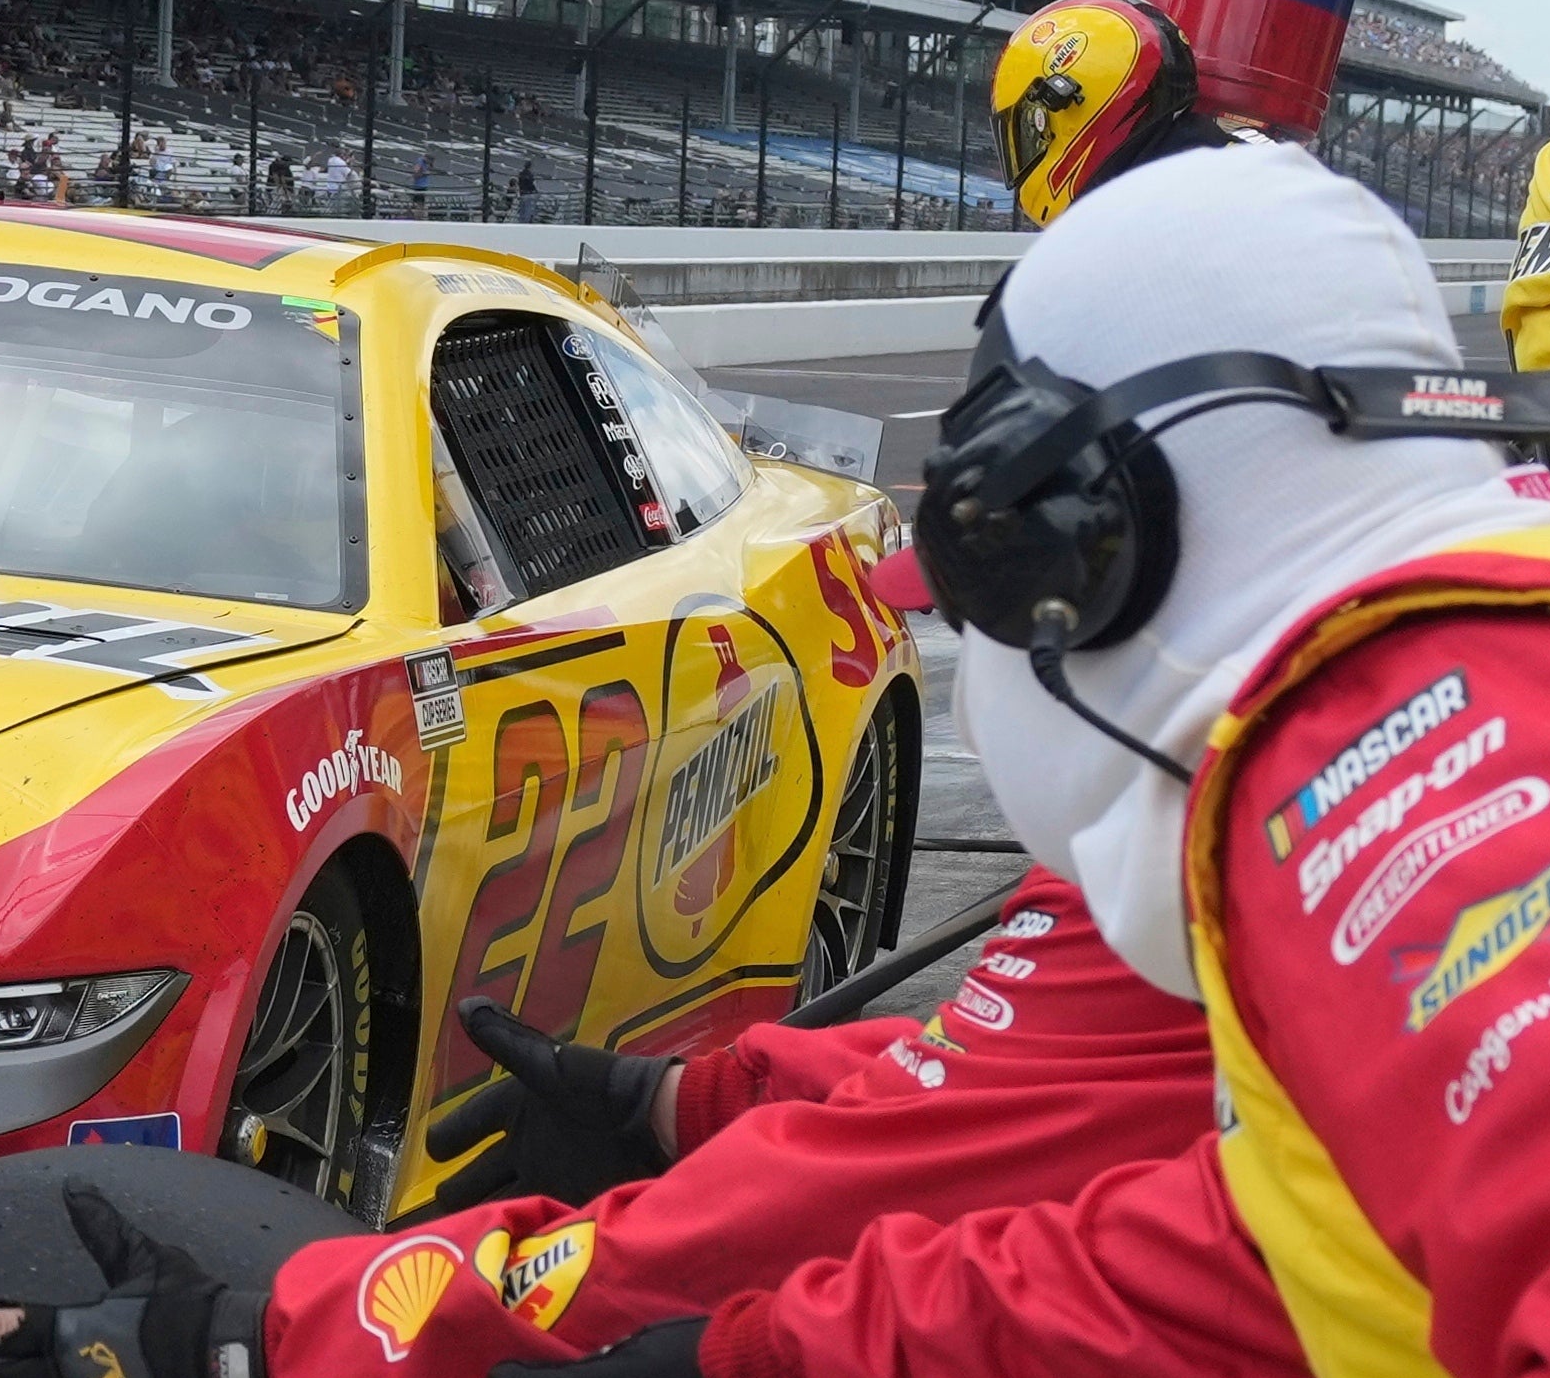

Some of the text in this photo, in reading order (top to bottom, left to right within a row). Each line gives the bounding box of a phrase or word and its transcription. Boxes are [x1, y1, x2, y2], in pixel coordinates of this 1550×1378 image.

[1049, 36, 1080, 73] PENNZOIL
[1402, 398, 1504, 421] PENSKE
[1413, 375, 1487, 398] TEAM
[422, 696, 456, 727] CUP SERIES
[1313, 672, 1468, 818] NASCAR
[287, 742, 402, 832] GOODYEAR
[652, 676, 780, 892] PENNZOIL
[1301, 717, 1506, 914] Snap-on
[441, 679, 650, 1097] 22
[1350, 789, 1526, 942] FREIGHTLINER
[502, 1239, 576, 1310] NZOIL
